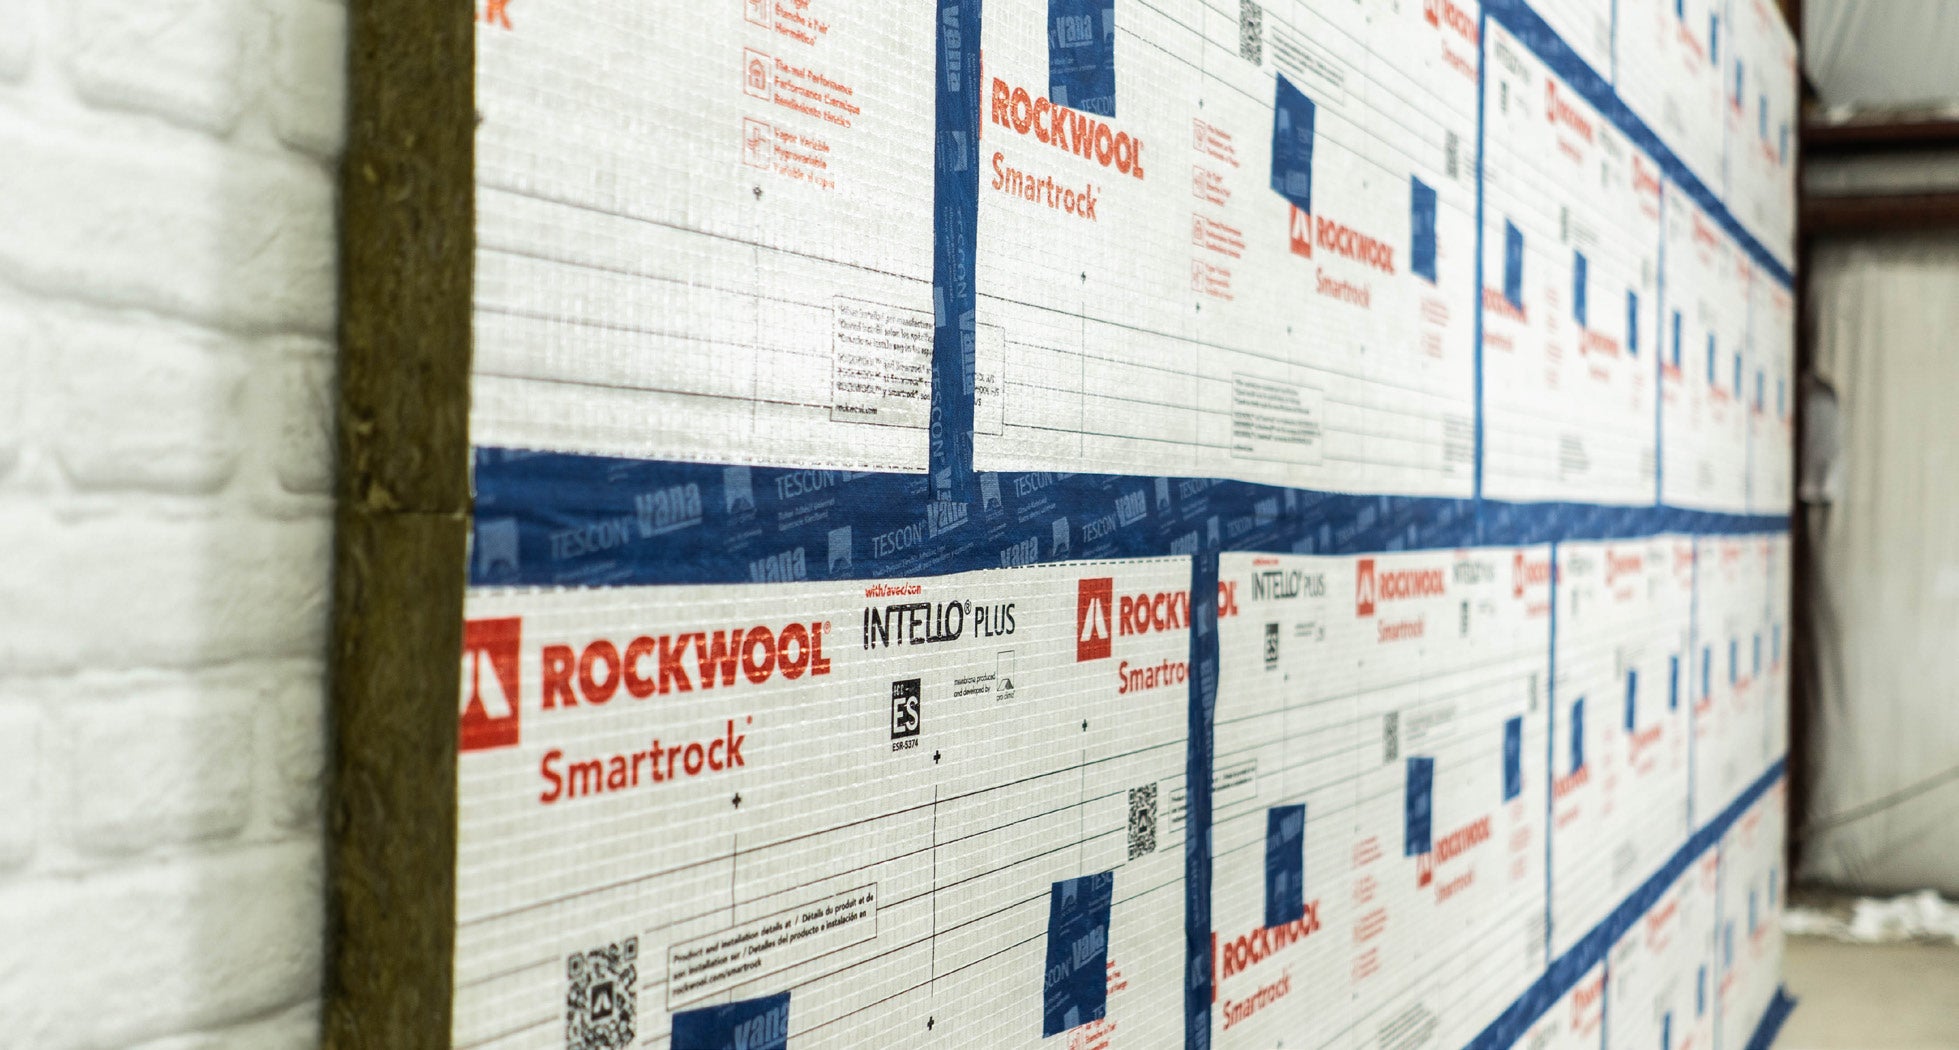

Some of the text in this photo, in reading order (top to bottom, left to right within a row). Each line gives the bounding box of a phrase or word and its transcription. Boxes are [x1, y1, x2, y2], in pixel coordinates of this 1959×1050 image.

[992, 77, 1144, 180] ROCKWOOL
[992, 151, 1097, 222] Smartrock
[872, 522, 923, 559] TESCON
[974, 603, 1016, 638] PLUS
[893, 696, 919, 734] ES
[892, 738, 919, 752] ESR-5374
